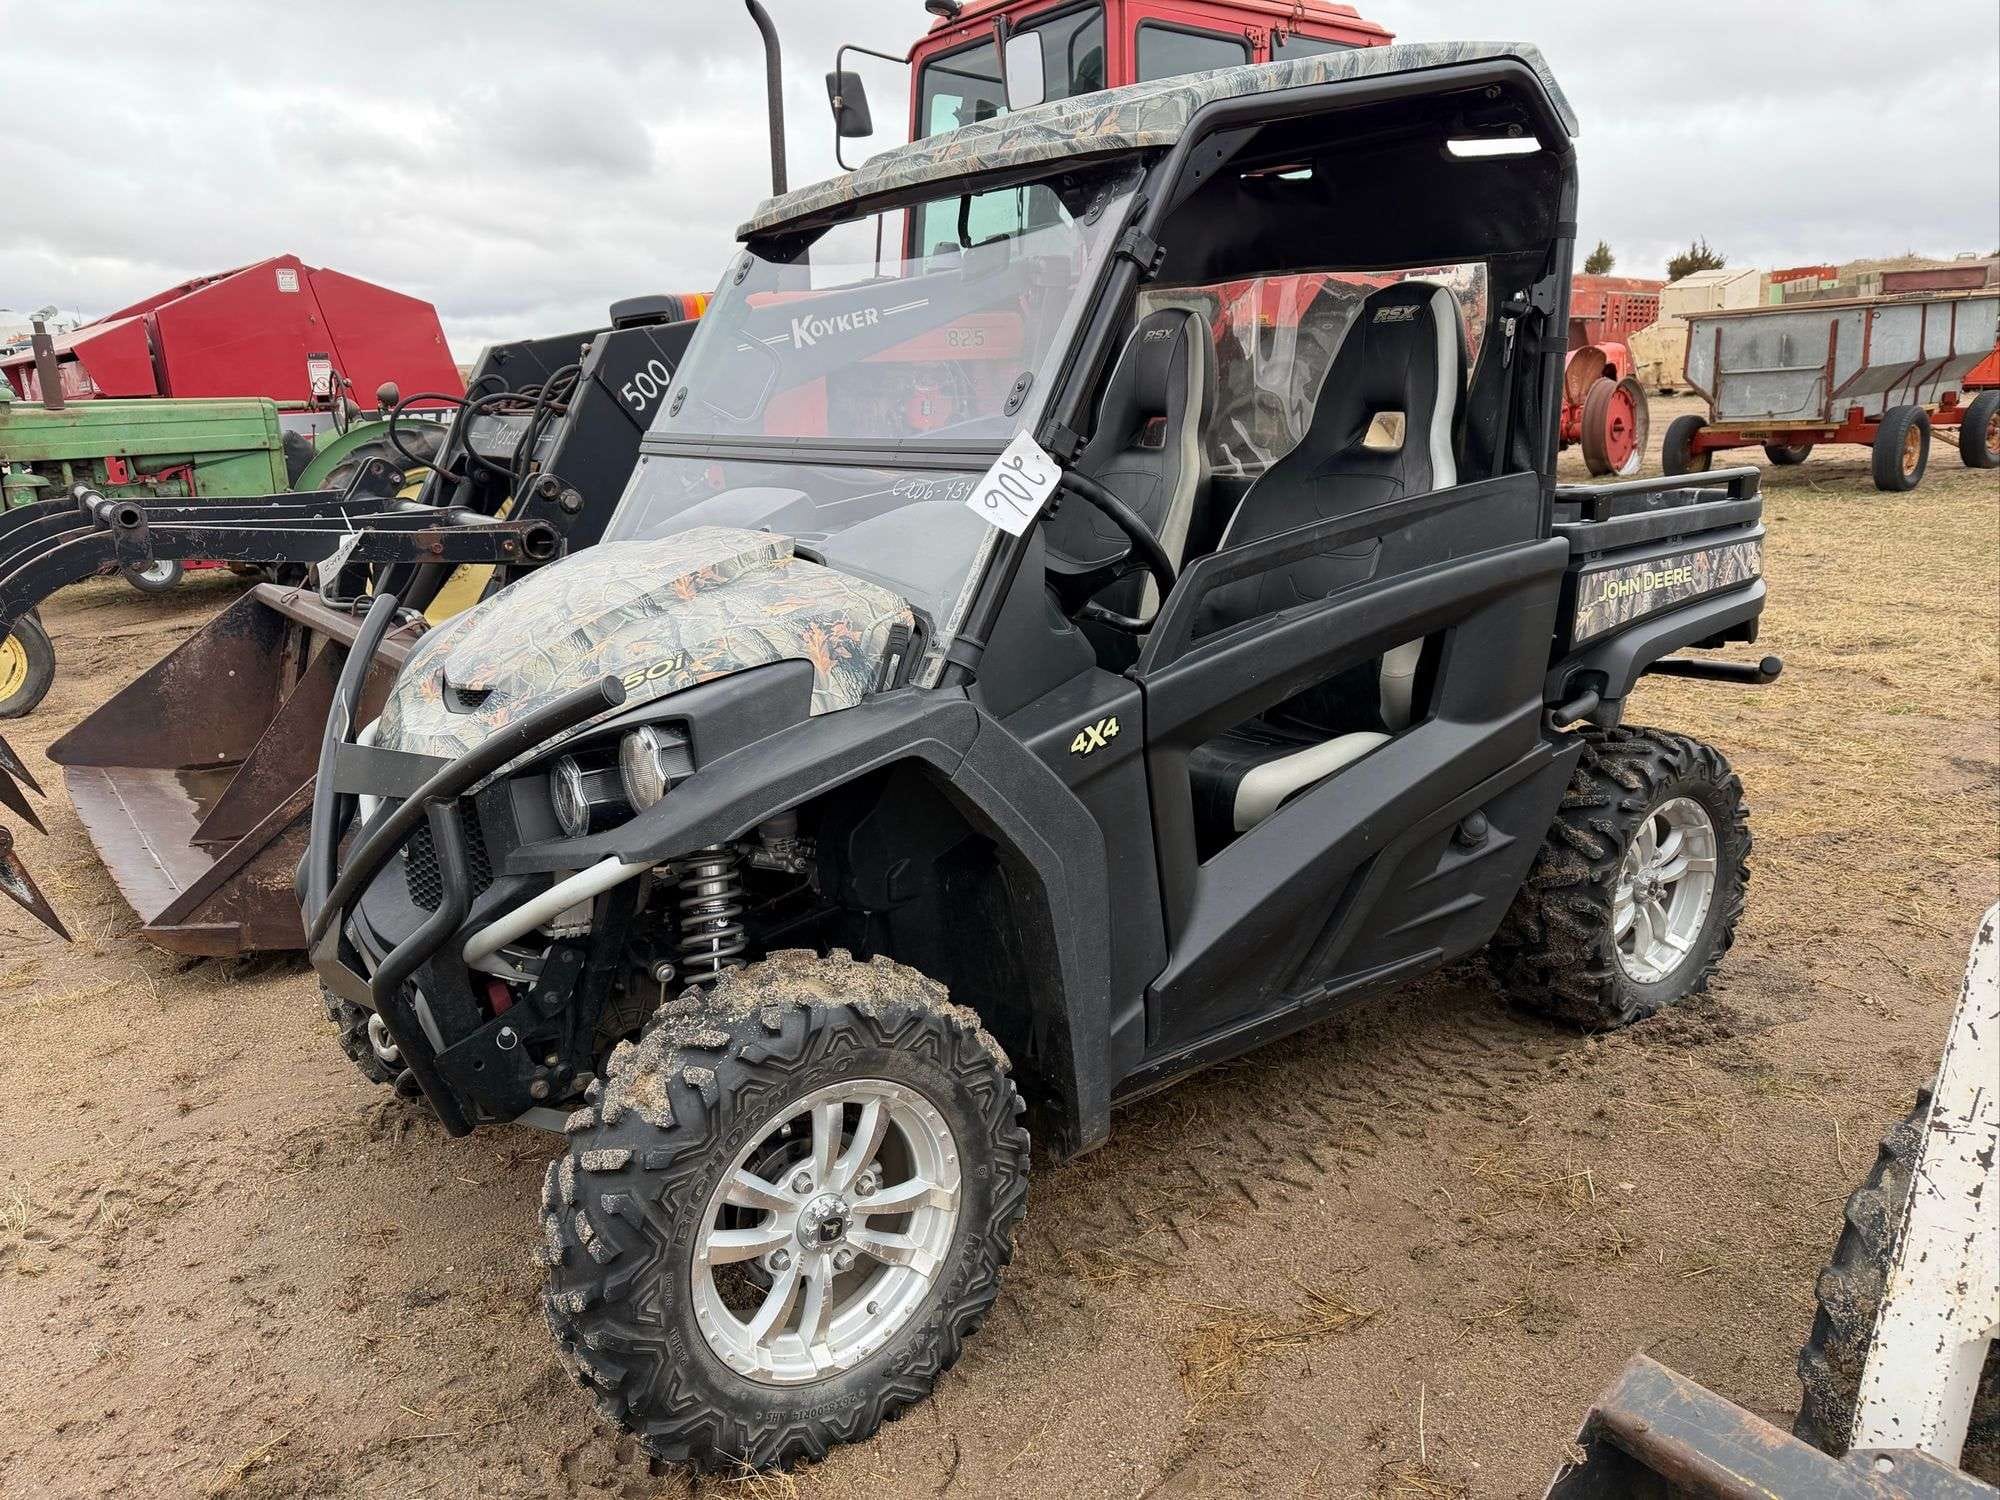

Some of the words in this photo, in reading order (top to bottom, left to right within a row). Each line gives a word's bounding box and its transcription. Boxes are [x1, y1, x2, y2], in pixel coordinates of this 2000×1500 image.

[791, 307, 879, 349] KOYKER
[1372, 305, 1420, 323] RSX
[948, 329, 985, 347] 825
[1143, 328, 1174, 343] RSX
[621, 359, 670, 411] 500
[1599, 575, 1640, 601] JOHN
[1643, 565, 1693, 592] DEERE
[623, 649, 685, 691] 50i
